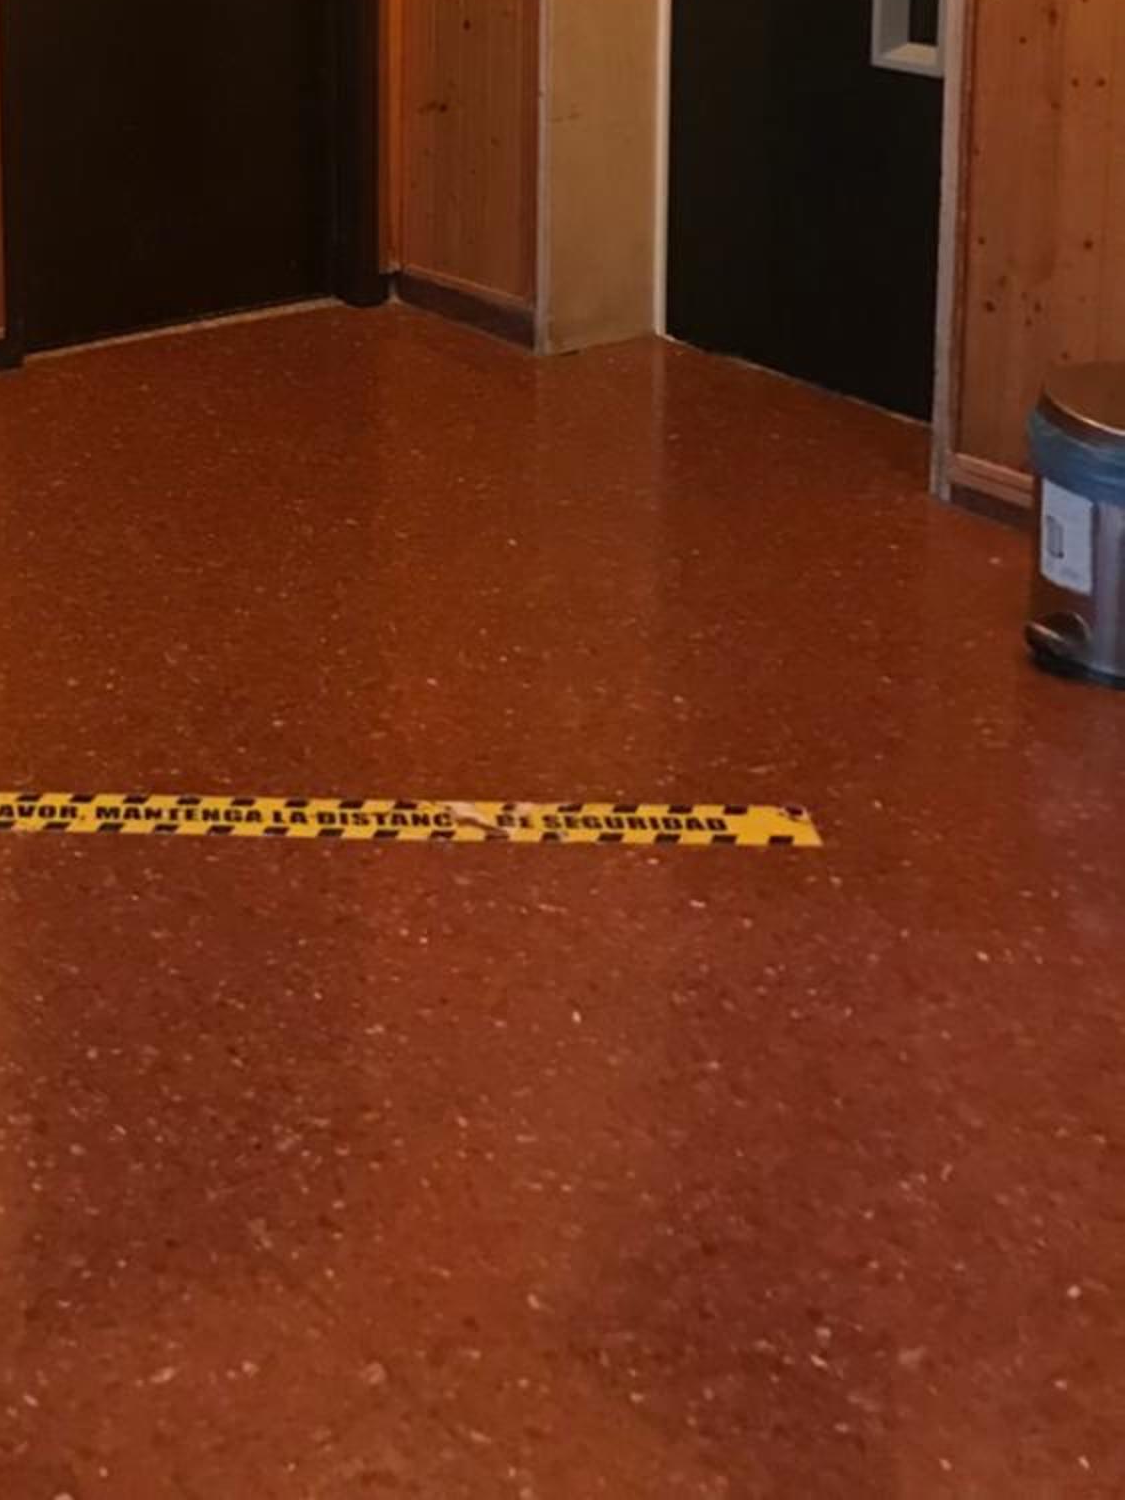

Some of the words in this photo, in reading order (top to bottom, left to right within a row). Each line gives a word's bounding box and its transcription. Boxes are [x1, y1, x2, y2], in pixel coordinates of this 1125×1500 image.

[95, 805, 263, 823] MANTENGA
[271, 810, 309, 825] LA
[316, 811, 455, 828] DISTANC
[541, 813, 728, 831] SEGURIDAD
